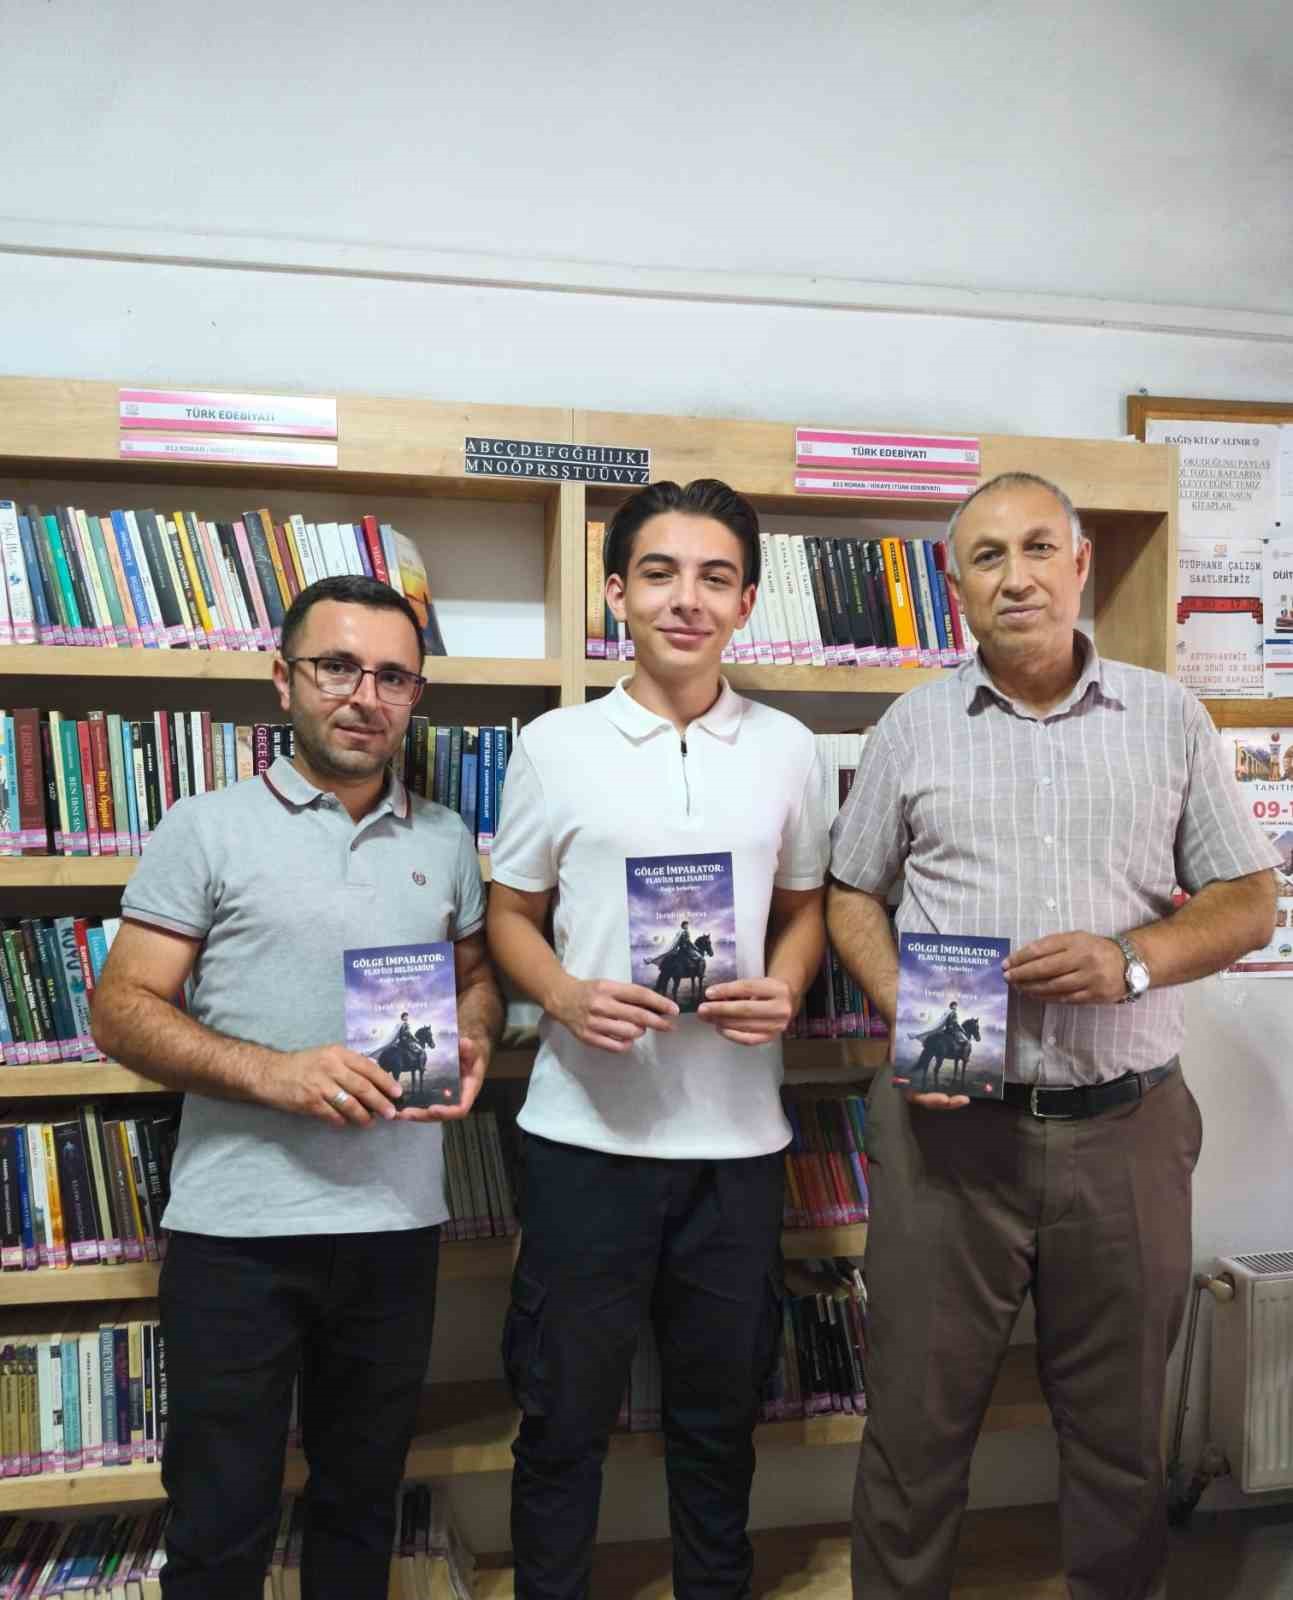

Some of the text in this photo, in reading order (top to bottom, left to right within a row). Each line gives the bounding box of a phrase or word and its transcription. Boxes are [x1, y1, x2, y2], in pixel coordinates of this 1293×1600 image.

[185, 407, 216, 419] TÜRK
[851, 446, 928, 460] TÜRK EDEBİYATI
[1179, 559, 1263, 572] ÜTÜPHANE ÇALIŞM
[257, 727, 267, 757] GECE
[634, 866, 665, 877] GÖLGE
[907, 942, 939, 953] GÖLGE
[353, 957, 385, 969] GÖLGE
